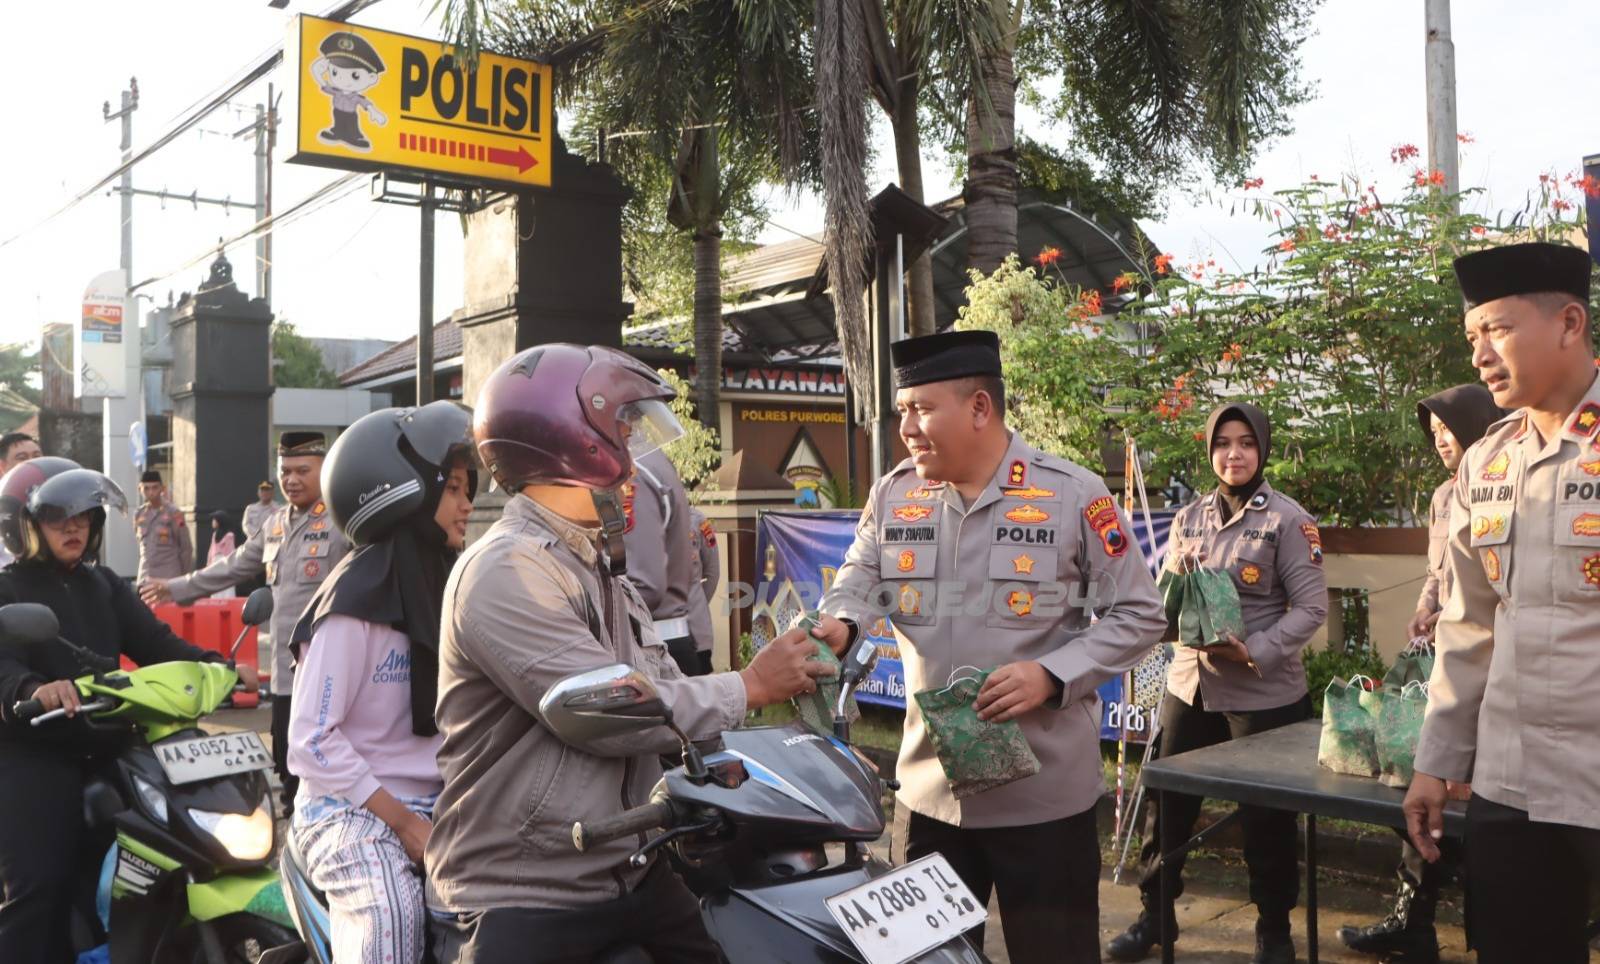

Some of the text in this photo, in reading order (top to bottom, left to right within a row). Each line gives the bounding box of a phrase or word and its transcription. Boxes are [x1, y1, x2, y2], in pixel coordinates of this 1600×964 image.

[400, 47, 541, 133] POLISI
[741, 410, 788, 421] POLRES
[304, 531, 328, 541] POLRI
[996, 527, 1055, 544] POLRI
[163, 735, 259, 763] AA 6052 TL
[121, 850, 160, 876] SUZUKI
[838, 865, 957, 931] AA 2886 TL
[926, 909, 949, 929] 01
